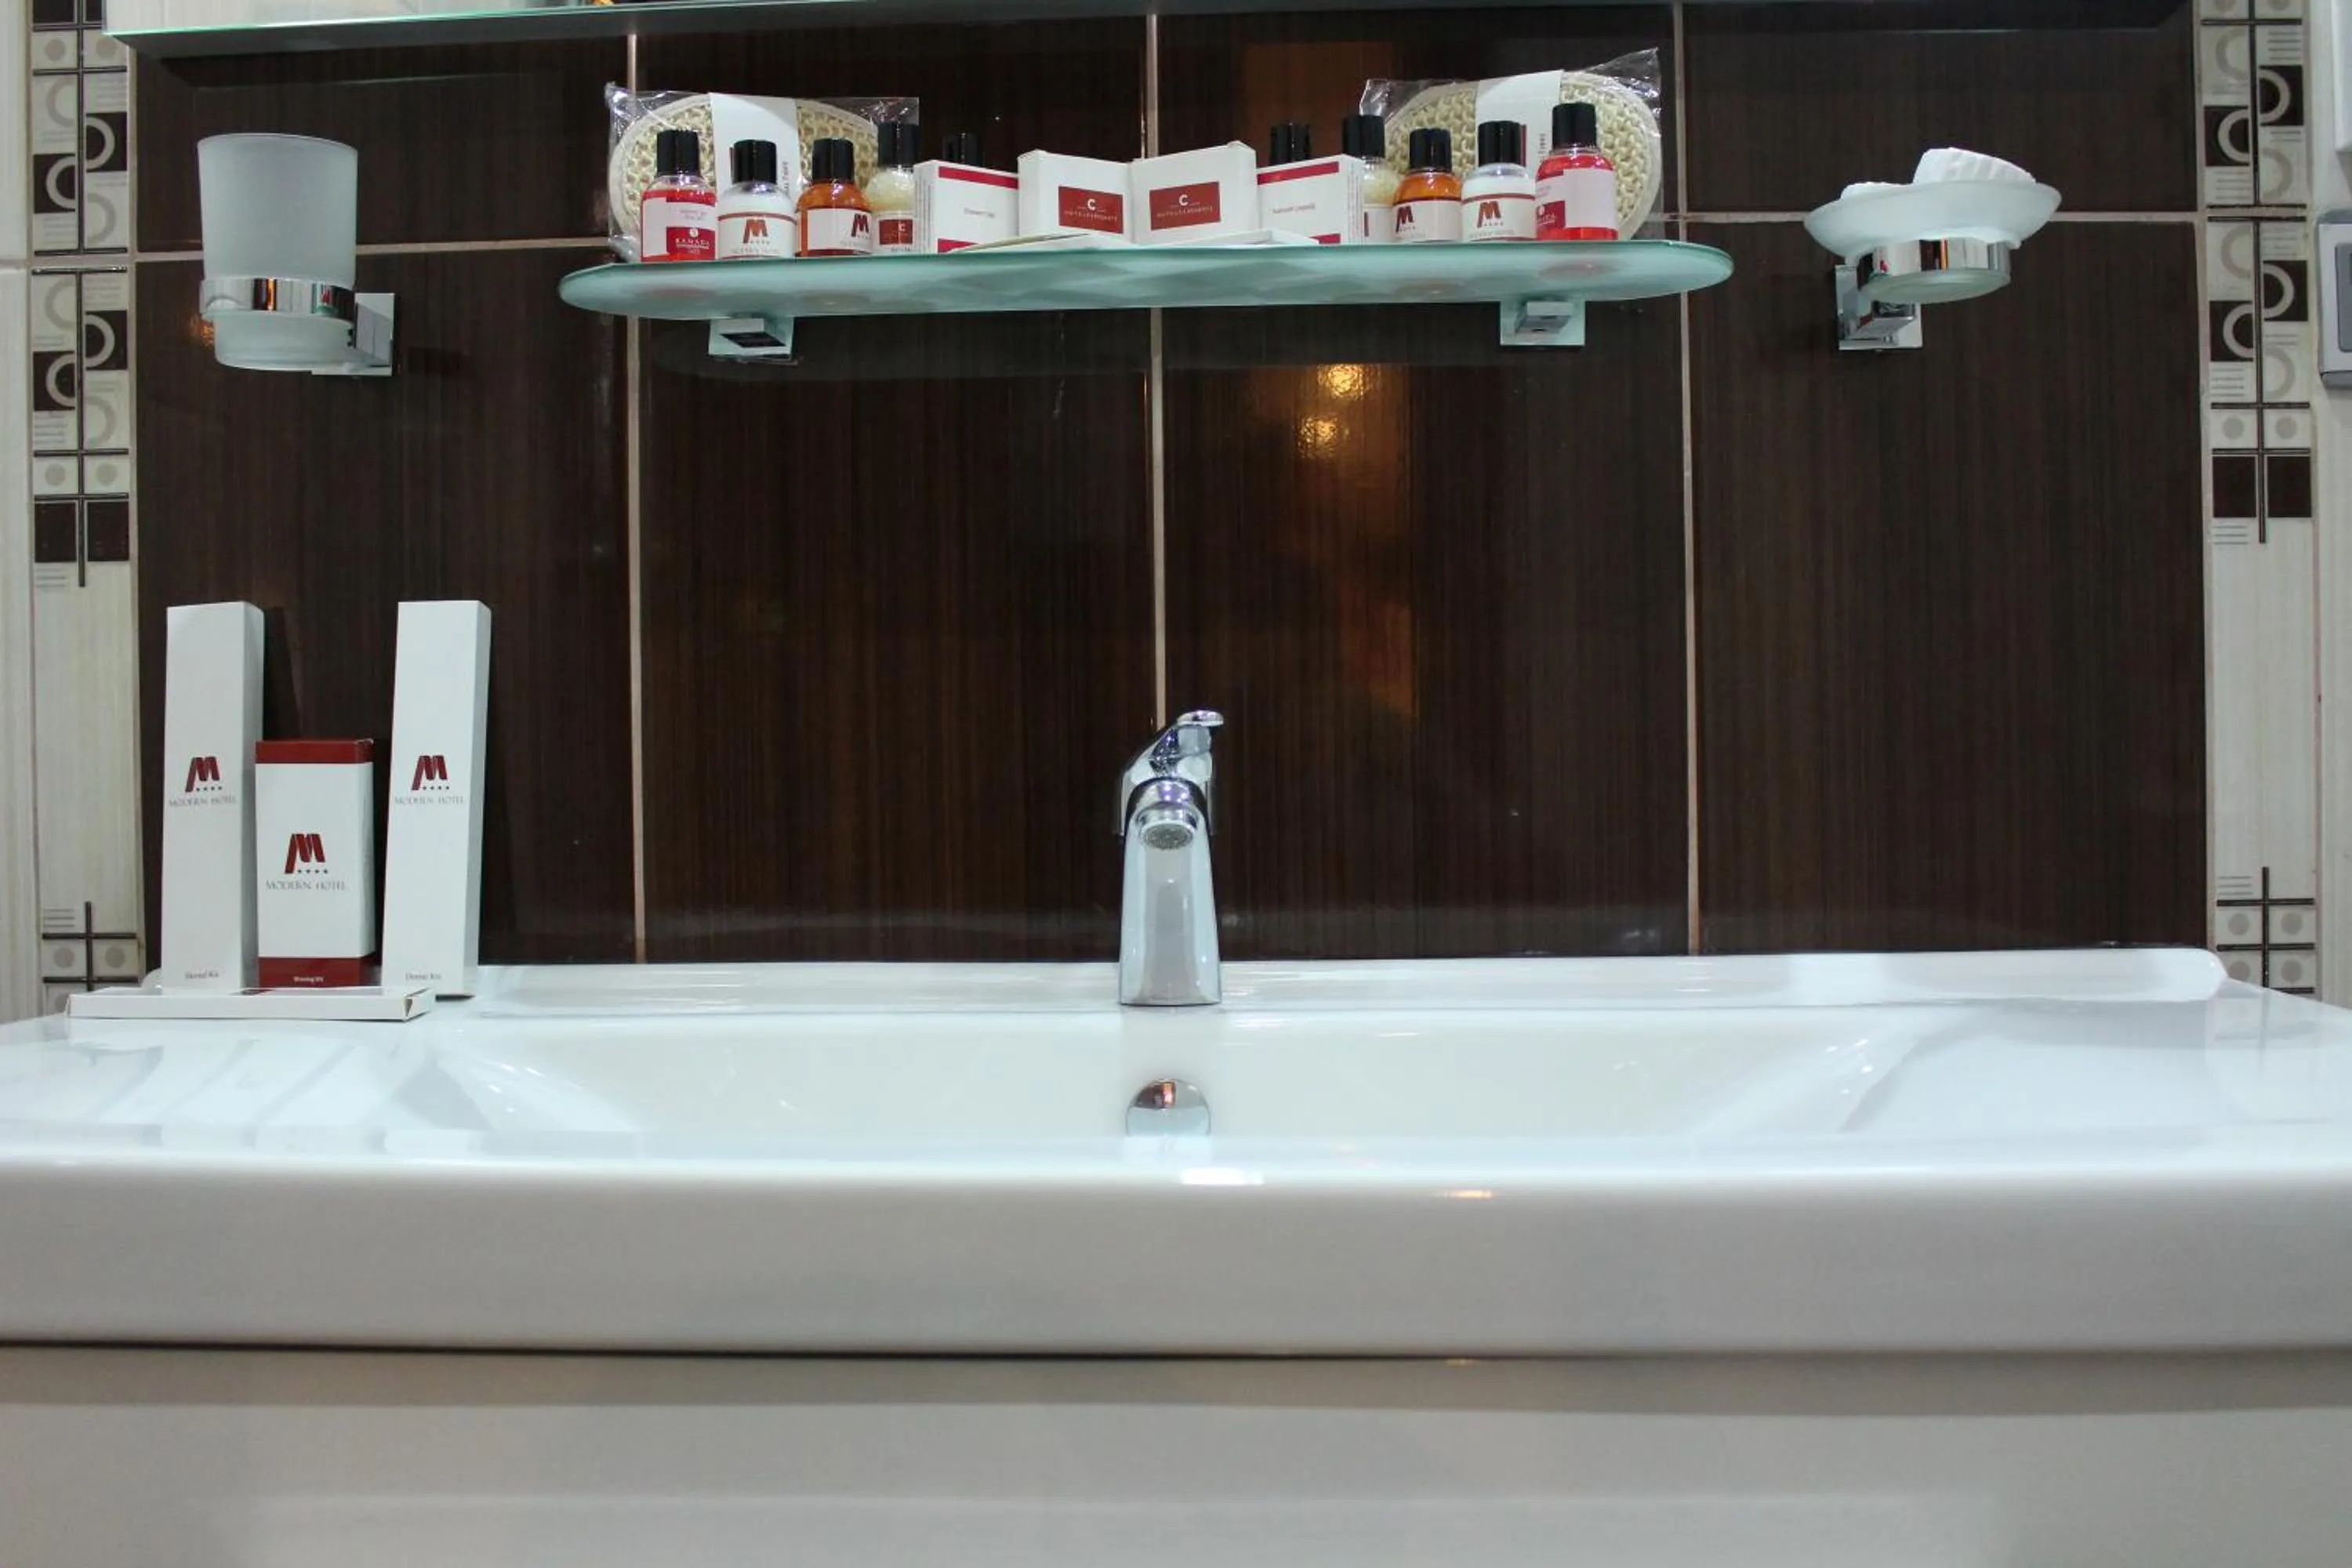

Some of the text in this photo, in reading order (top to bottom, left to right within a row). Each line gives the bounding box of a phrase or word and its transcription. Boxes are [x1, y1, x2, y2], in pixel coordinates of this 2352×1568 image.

[1087, 198, 1095, 211] C
[1179, 194, 1189, 206] C
[185, 757, 220, 793] M
[411, 755, 448, 791] M
[169, 796, 238, 807] MODERN HOTEL
[394, 796, 464, 805] MODERN HOTEL
[285, 833, 326, 874] M
[266, 880, 346, 891] MODERN HOTEL
